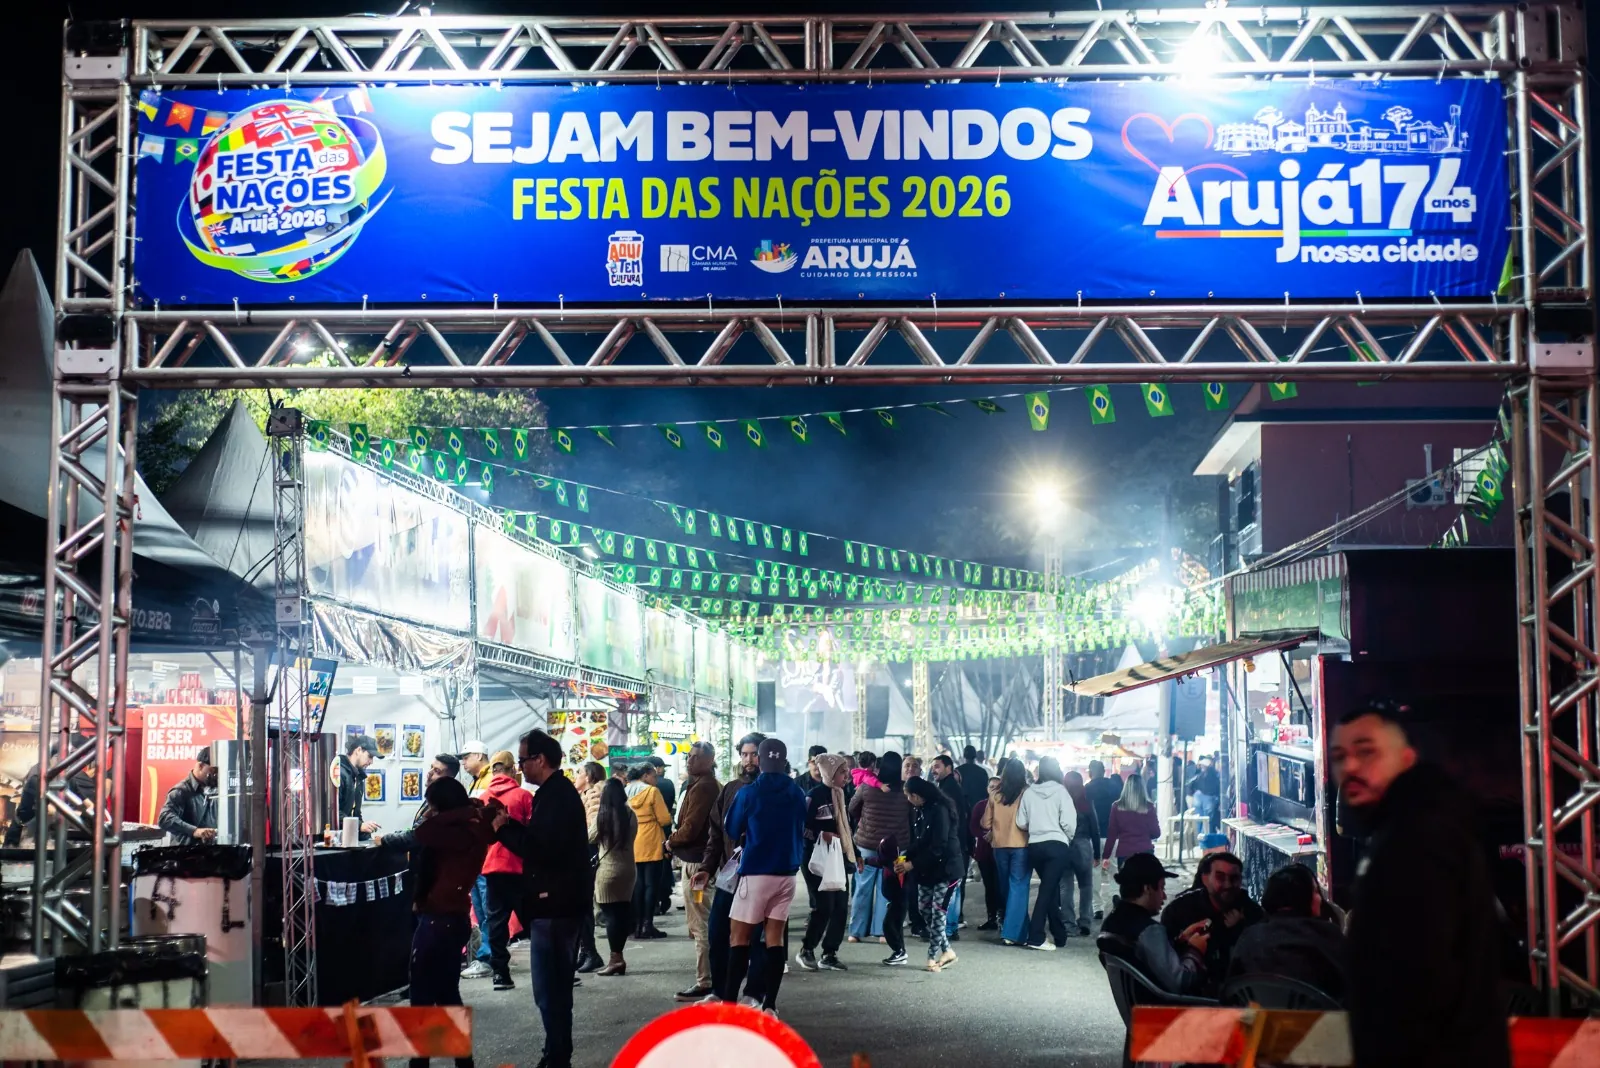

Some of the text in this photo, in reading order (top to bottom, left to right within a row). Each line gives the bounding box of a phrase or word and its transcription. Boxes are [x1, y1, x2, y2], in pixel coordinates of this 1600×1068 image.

[430, 107, 1093, 164] SEJAM BEM-VINDOS
[217, 148, 345, 179] FESTA das
[216, 171, 352, 212] NAÇÕES
[512, 169, 1011, 227] FESTA DAS NAÇÕES 2026
[1431, 199, 1470, 209] anos
[230, 208, 326, 234] Arujá 2026
[692, 245, 738, 261] CMA
[801, 238, 917, 270] ARUJÁ
[1300, 238, 1479, 263] nossa cidade
[611, 274, 641, 284] CULTURA
[619, 259, 641, 274] TEM
[147, 712, 205, 729] O SABOR
[147, 729, 193, 745] DE SER
